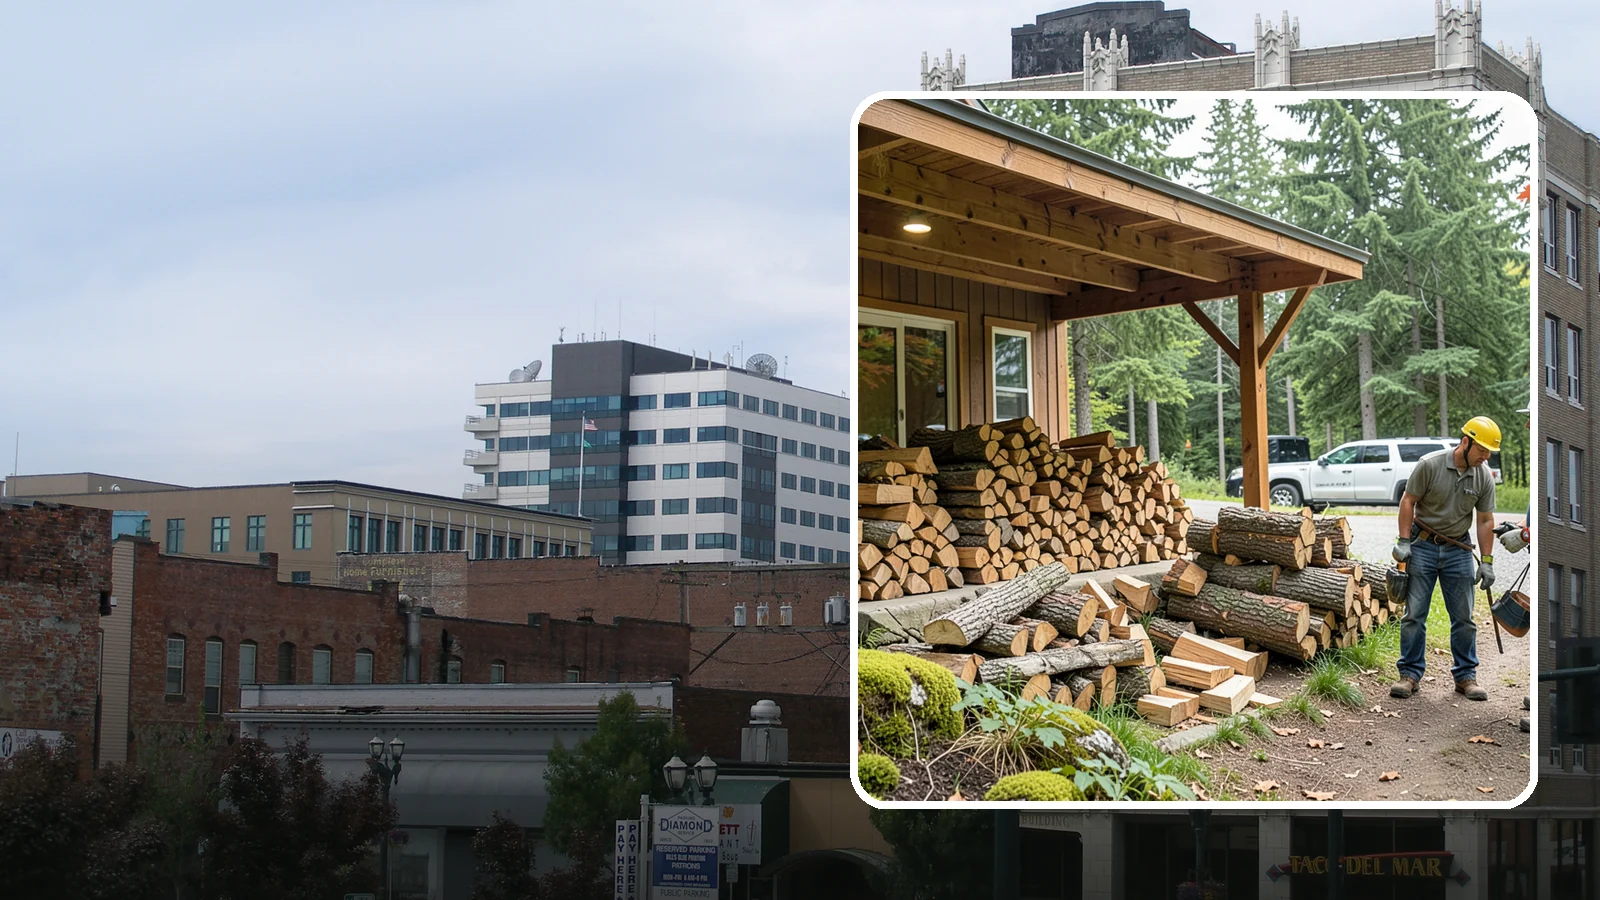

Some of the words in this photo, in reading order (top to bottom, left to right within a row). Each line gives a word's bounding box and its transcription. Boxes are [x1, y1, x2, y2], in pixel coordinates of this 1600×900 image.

[343, 568, 368, 577] Home
[370, 566, 427, 577] Furnishers
[660, 818, 713, 832] DIAMOND
[1022, 815, 1070, 828] BUILDING
[617, 825, 625, 852] PAY
[628, 824, 637, 850] PAY
[656, 845, 688, 853] RESERVED
[689, 846, 716, 854] PARKING
[671, 862, 701, 870] PATRONS
[1346, 856, 1385, 876] DEL
[1392, 857, 1442, 877] MAR
[617, 856, 625, 893] HERE
[628, 856, 636, 893] HERE
[661, 889, 682, 897] PUBLIC
[683, 890, 710, 898] PARKING
